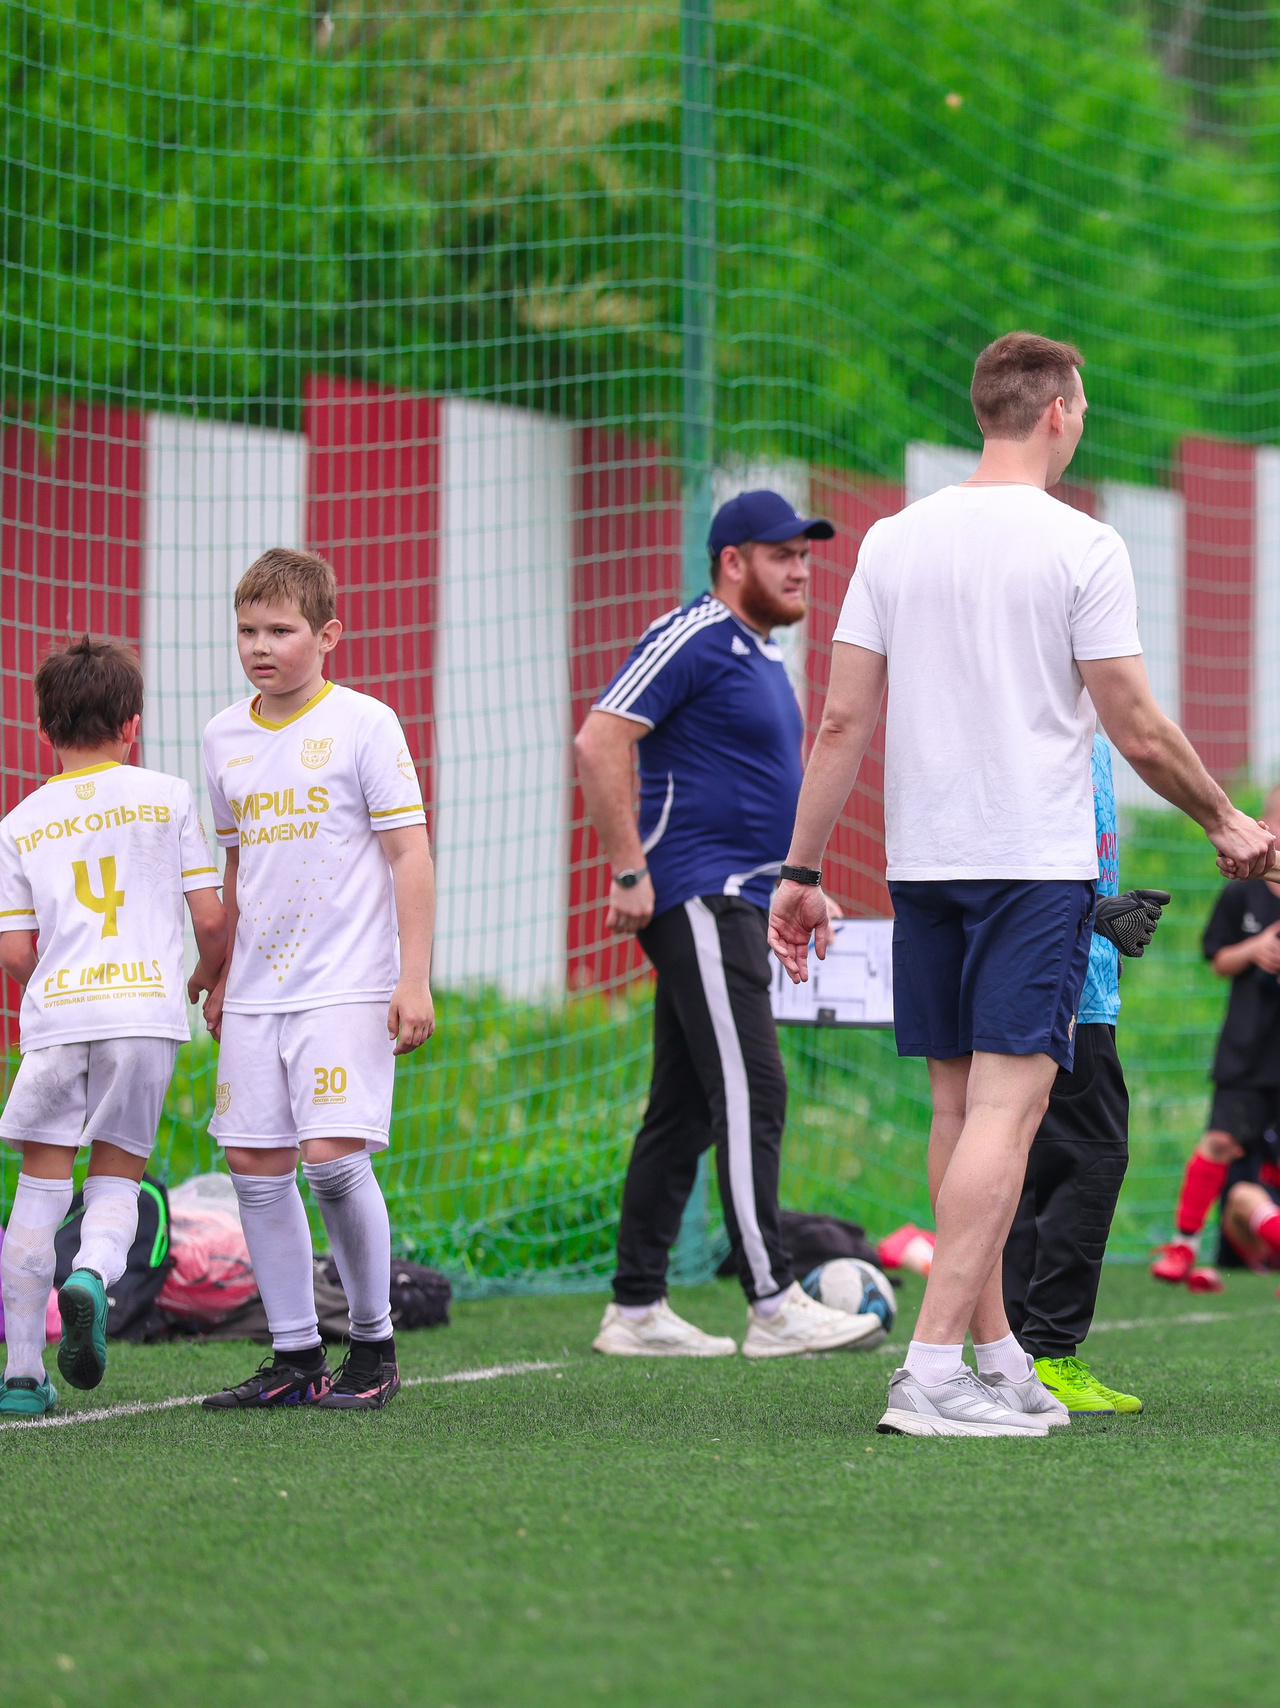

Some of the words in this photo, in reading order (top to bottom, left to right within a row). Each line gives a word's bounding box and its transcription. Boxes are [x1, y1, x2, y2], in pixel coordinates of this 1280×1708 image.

[228, 786, 330, 824] MPULS
[15, 804, 171, 855] ПРОКОПЬЕВ
[240, 821, 320, 848] ACADEMY
[71, 855, 125, 940] 4
[44, 968, 70, 992] FC
[79, 959, 163, 986] IMPULS
[43, 995, 86, 1009] ФУТБОЛЬНАЯ
[86, 993, 111, 1003] ШКОЛА
[112, 991, 137, 1000] СЕРГЕЯ
[313, 1066, 347, 1095] 30
